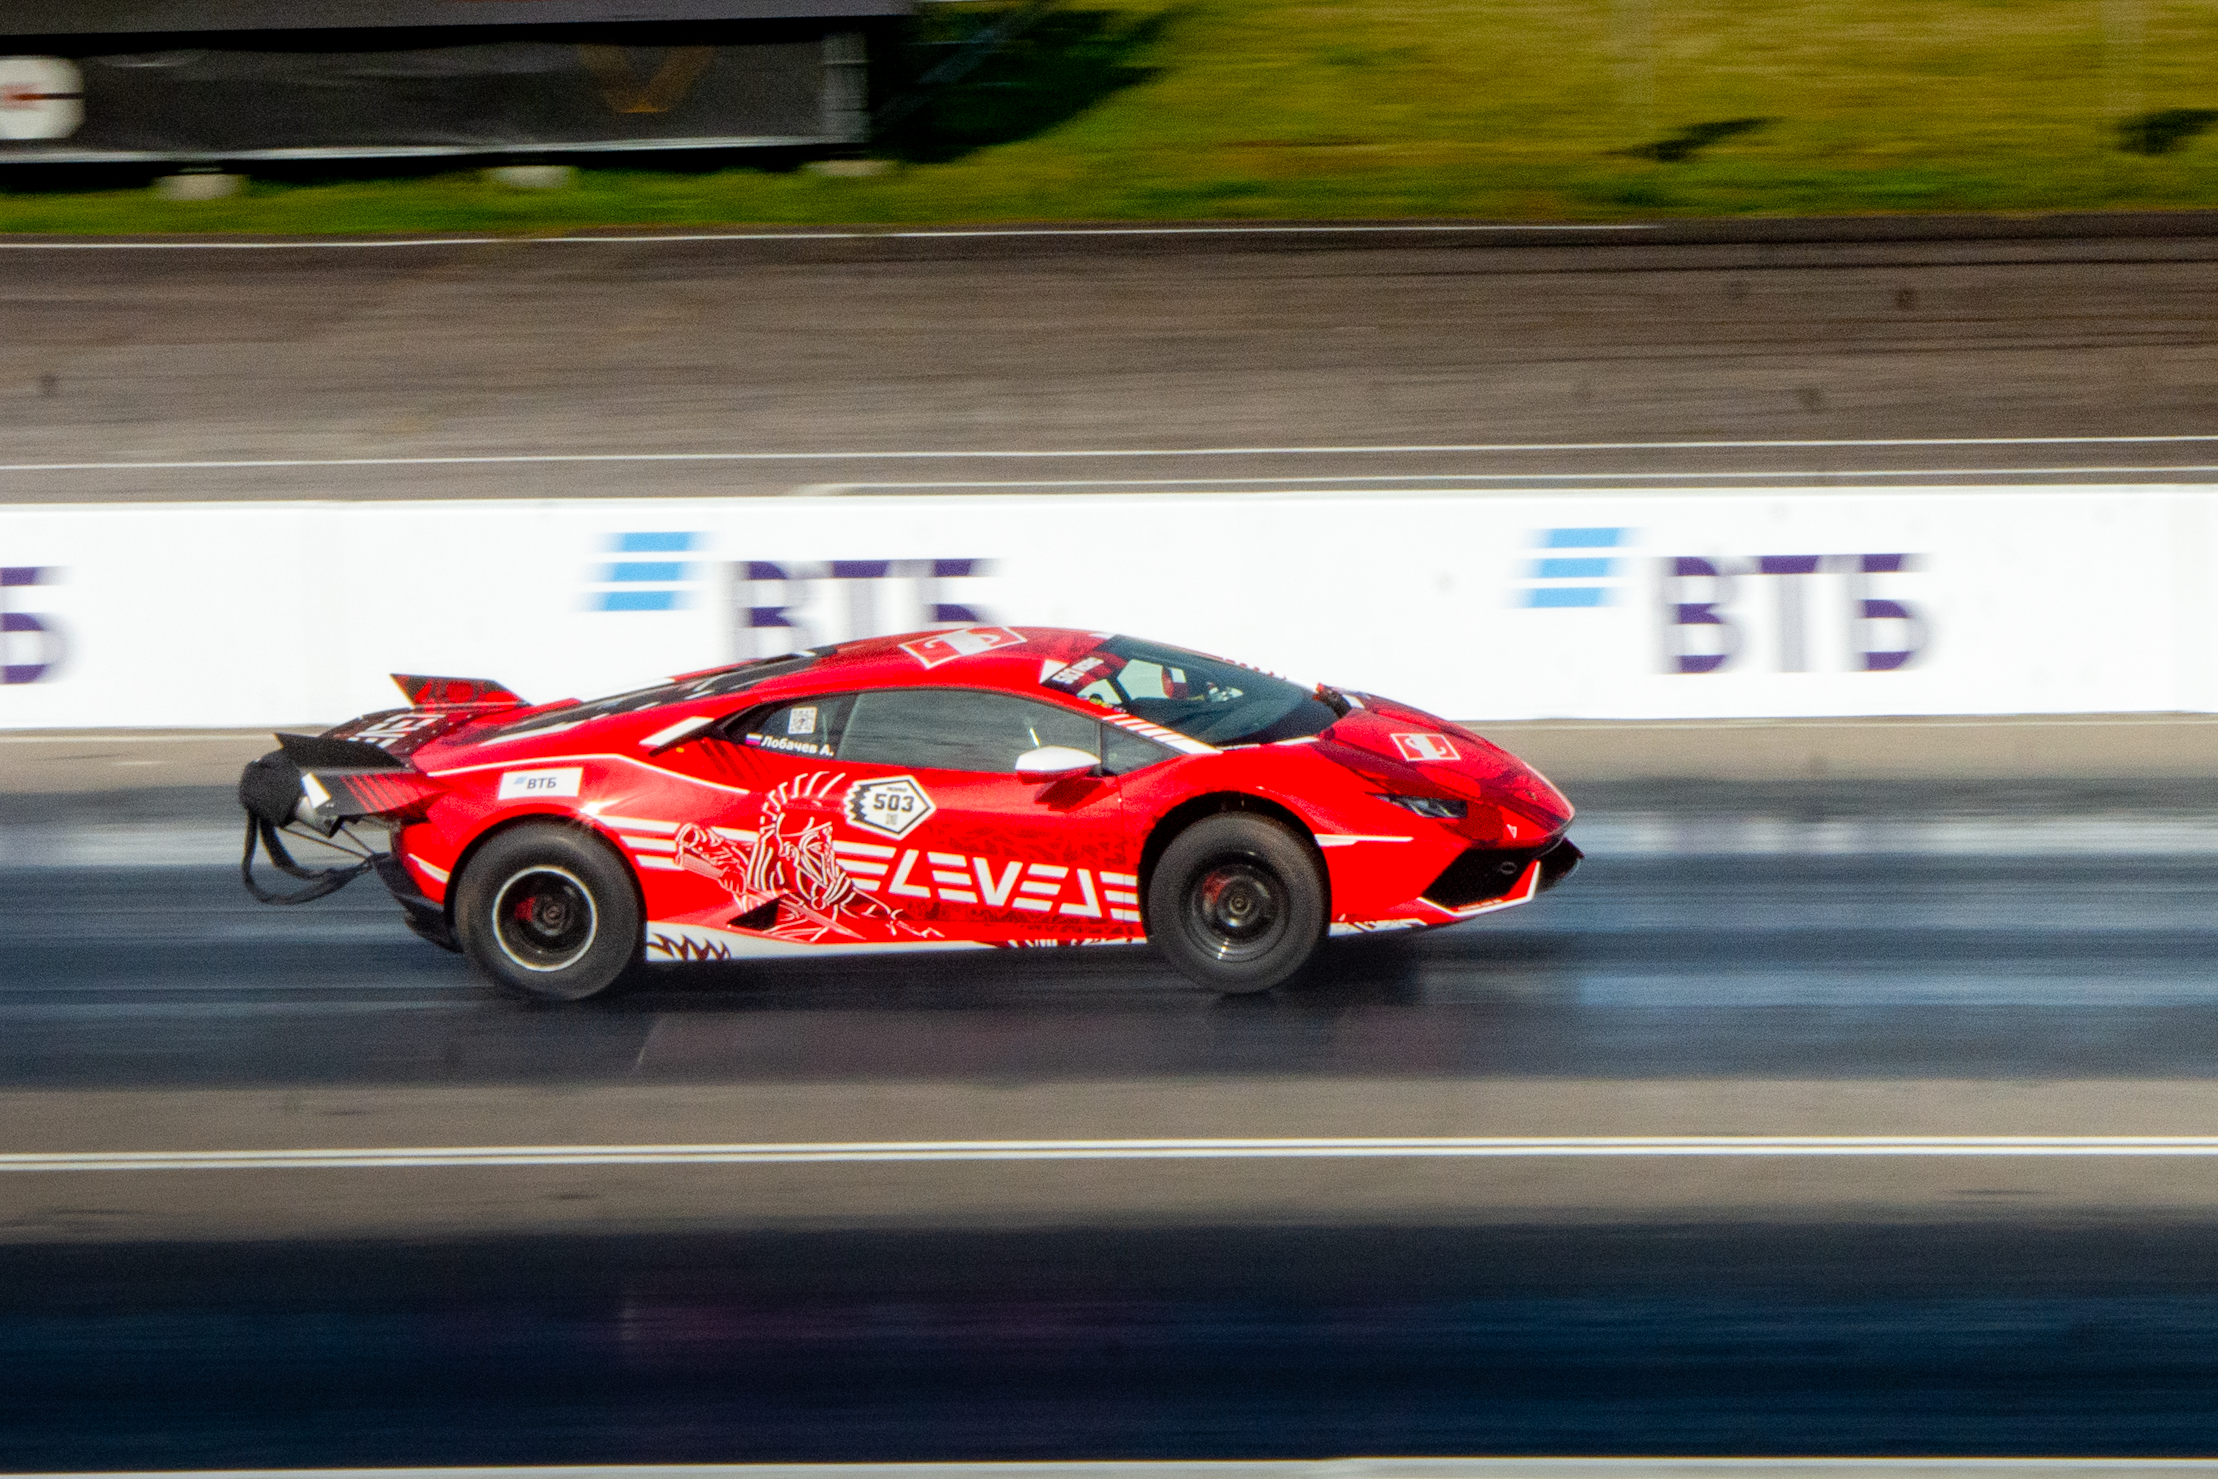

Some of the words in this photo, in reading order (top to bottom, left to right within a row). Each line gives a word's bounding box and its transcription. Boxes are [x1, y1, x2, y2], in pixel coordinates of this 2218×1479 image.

[1654, 553, 1940, 674] ВТБ
[761, 735, 818, 754] Лобачев
[526, 777, 557, 790] ВТБ
[872, 793, 914, 813] 503
